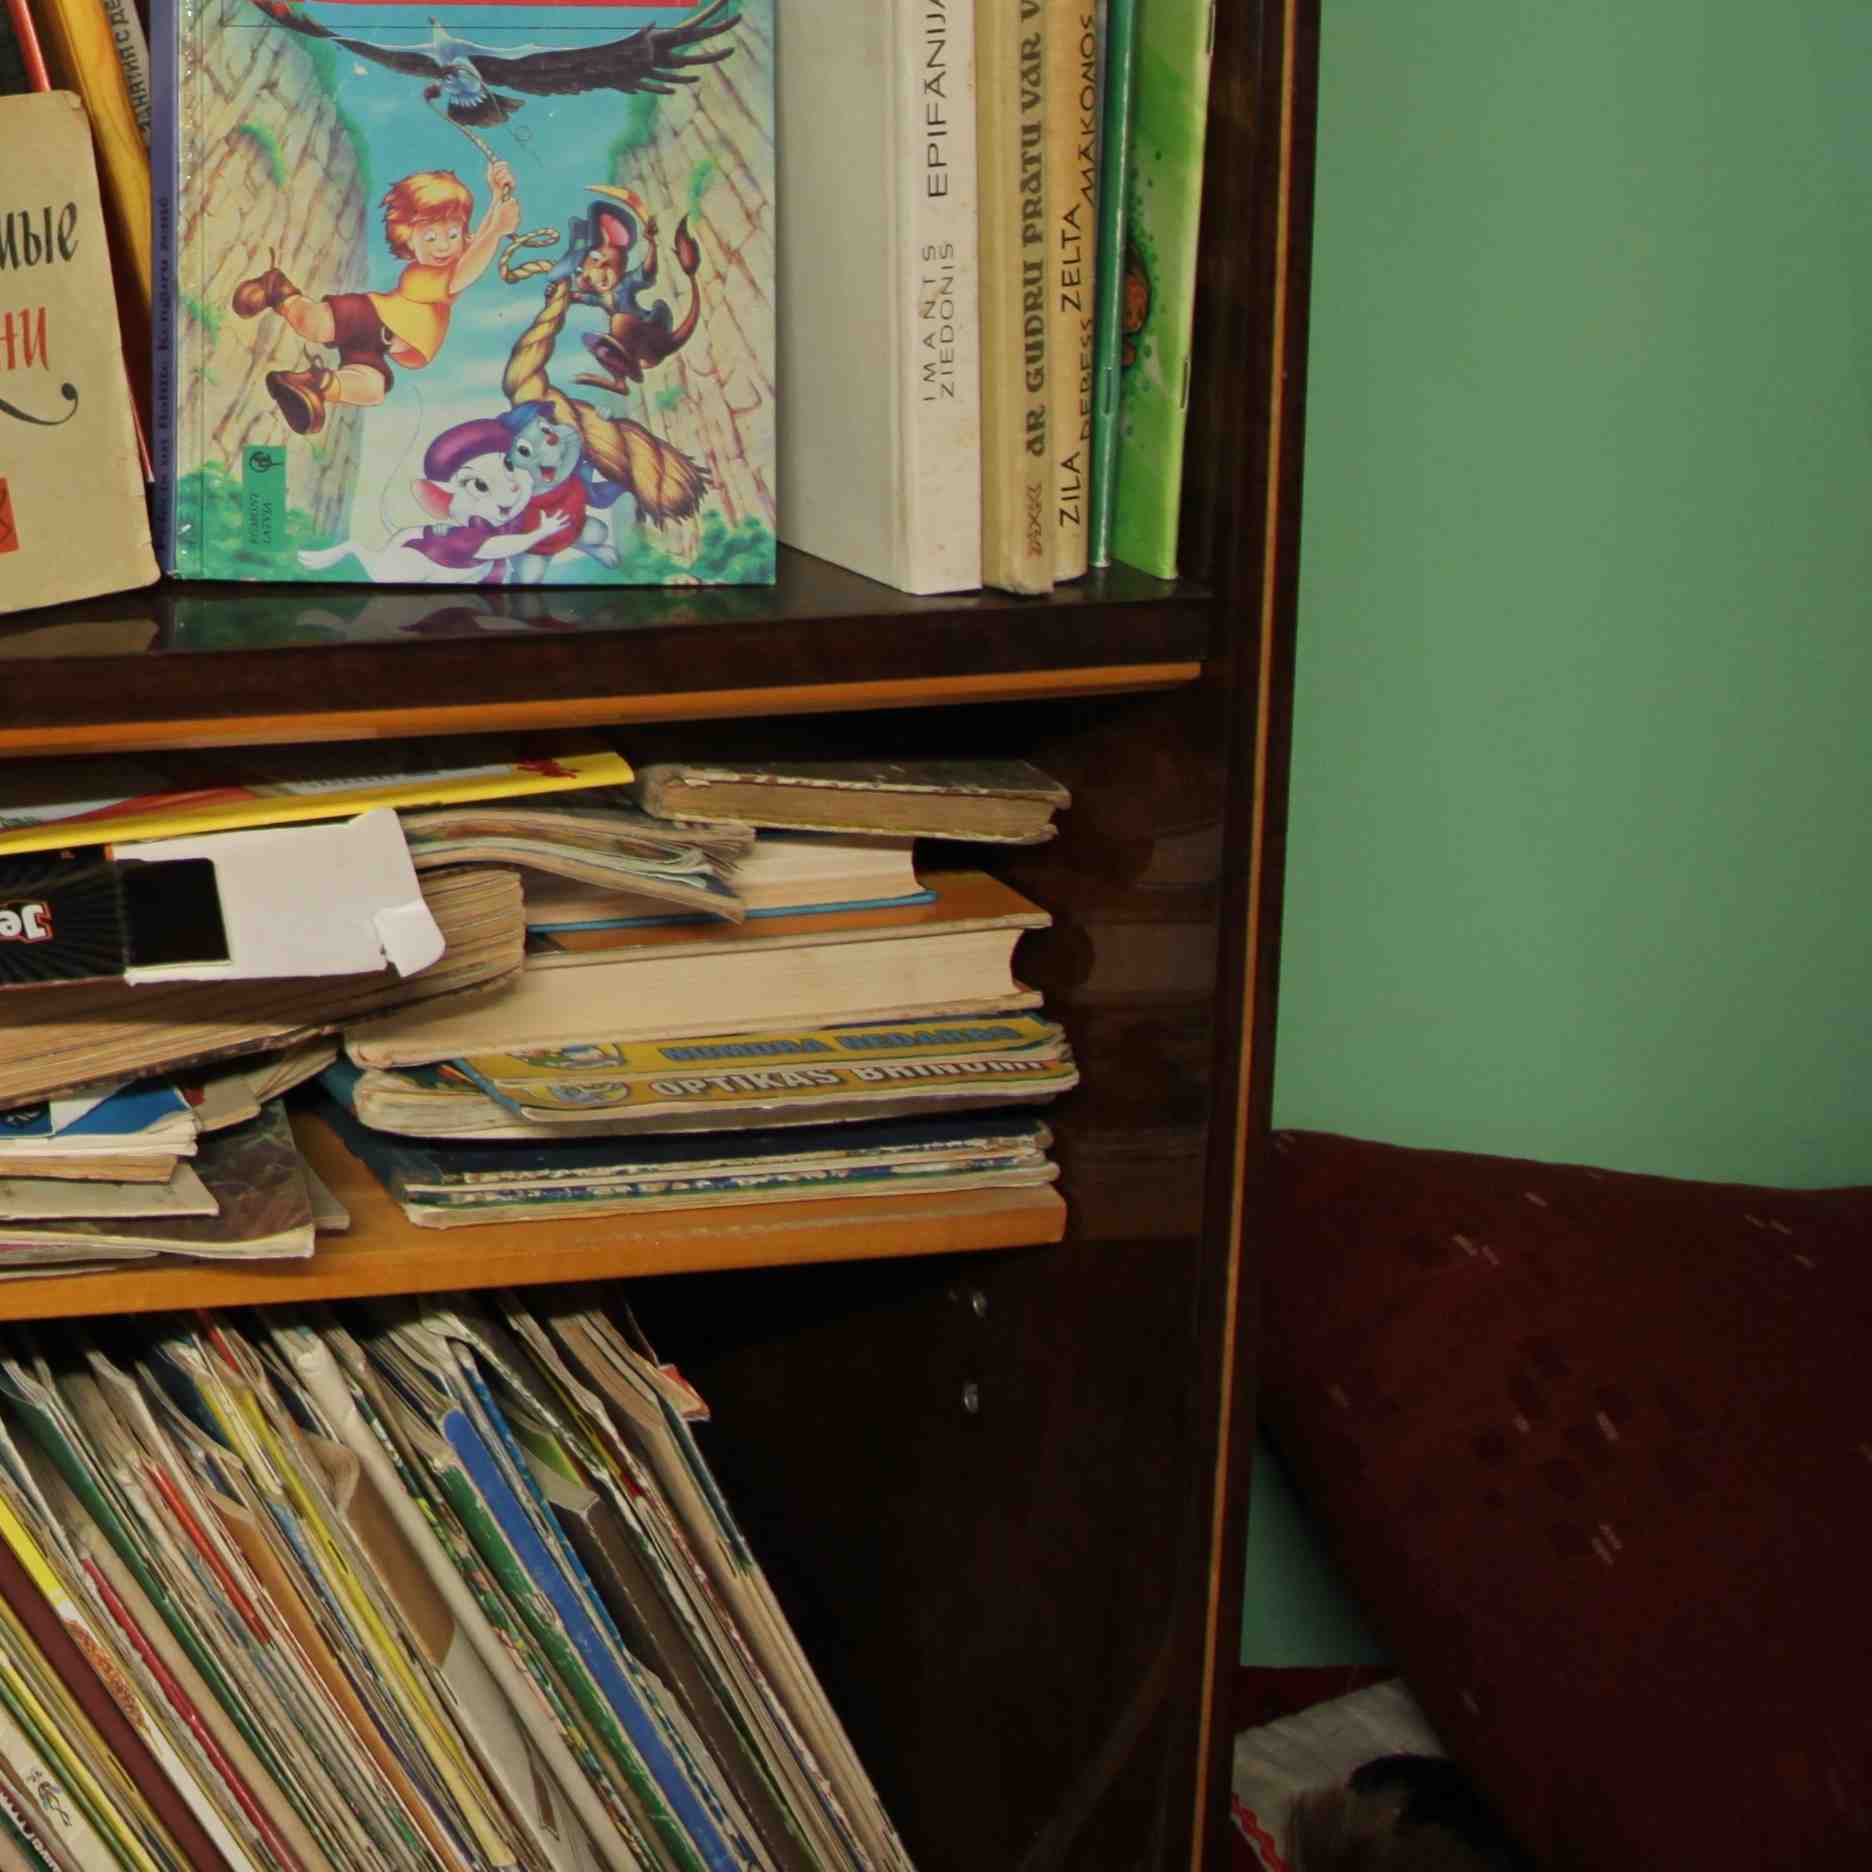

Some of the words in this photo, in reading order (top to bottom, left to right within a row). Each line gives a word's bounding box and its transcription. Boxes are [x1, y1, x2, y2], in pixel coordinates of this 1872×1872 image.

[1020, 31, 1042, 113] VAR
[1076, 14, 1095, 209] MĀKONOS
[1061, 204, 1081, 313] ZELTA
[922, 244, 937, 403] IMANTS
[938, 242, 956, 400] ZIEDONIS
[1024, 259, 1045, 393] GUDRU
[1059, 450, 1081, 529] ZILA
[653, 1067, 844, 1098] OPTIKAS
